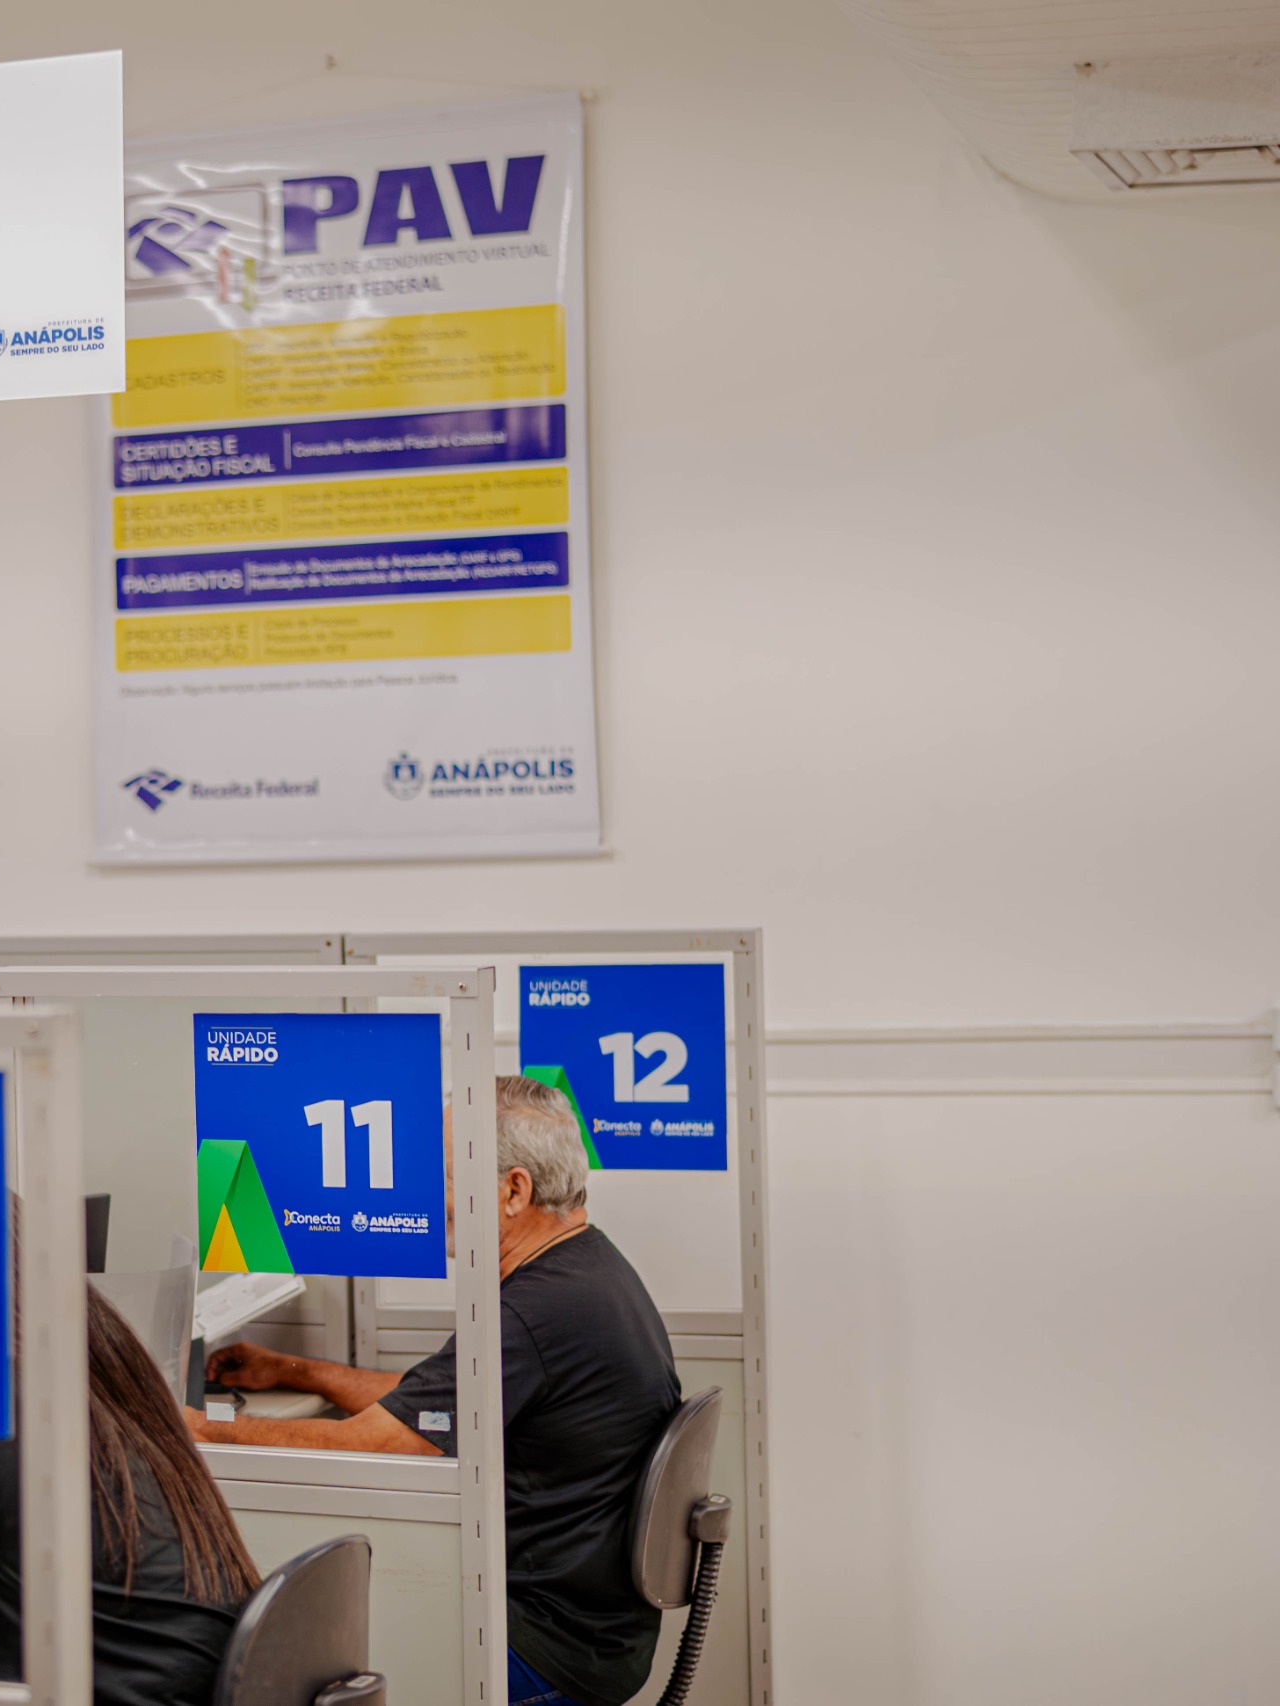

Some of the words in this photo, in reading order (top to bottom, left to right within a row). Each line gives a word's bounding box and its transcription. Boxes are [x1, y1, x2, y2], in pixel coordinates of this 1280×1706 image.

[282, 155, 545, 256] PAV
[479, 242, 552, 263] VIRTUAL
[363, 276, 445, 299] FEDERAL
[48, 318, 92, 327] PREFEITURA
[11, 325, 105, 346] ANÁPOLIS
[10, 347, 45, 357] SEMPRE
[47, 346, 60, 354] DO
[62, 344, 79, 352] SEU
[81, 343, 105, 351] LADO
[121, 435, 223, 462] CERTIDÕES
[223, 434, 238, 455] E
[121, 456, 211, 483] SITUAÇÃO
[212, 452, 276, 476] FISCAL
[122, 569, 244, 595] PAGAMENTOS
[431, 756, 575, 782] ANÁPOLIS
[189, 780, 253, 800] Receita
[255, 777, 319, 798] Federal
[529, 979, 588, 992] UNIDADE
[529, 991, 590, 1006] RÁPIDO
[207, 1030, 277, 1045] UNIDADE
[207, 1044, 278, 1062] RÁPIDO
[598, 1031, 689, 1103] 12
[598, 1119, 642, 1132] Conecta
[303, 1099, 394, 1189] 11
[289, 1210, 340, 1225] Conecta
[309, 1224, 340, 1232] ANÁPOLIS
[370, 1215, 429, 1228] ANÁPOLIS
